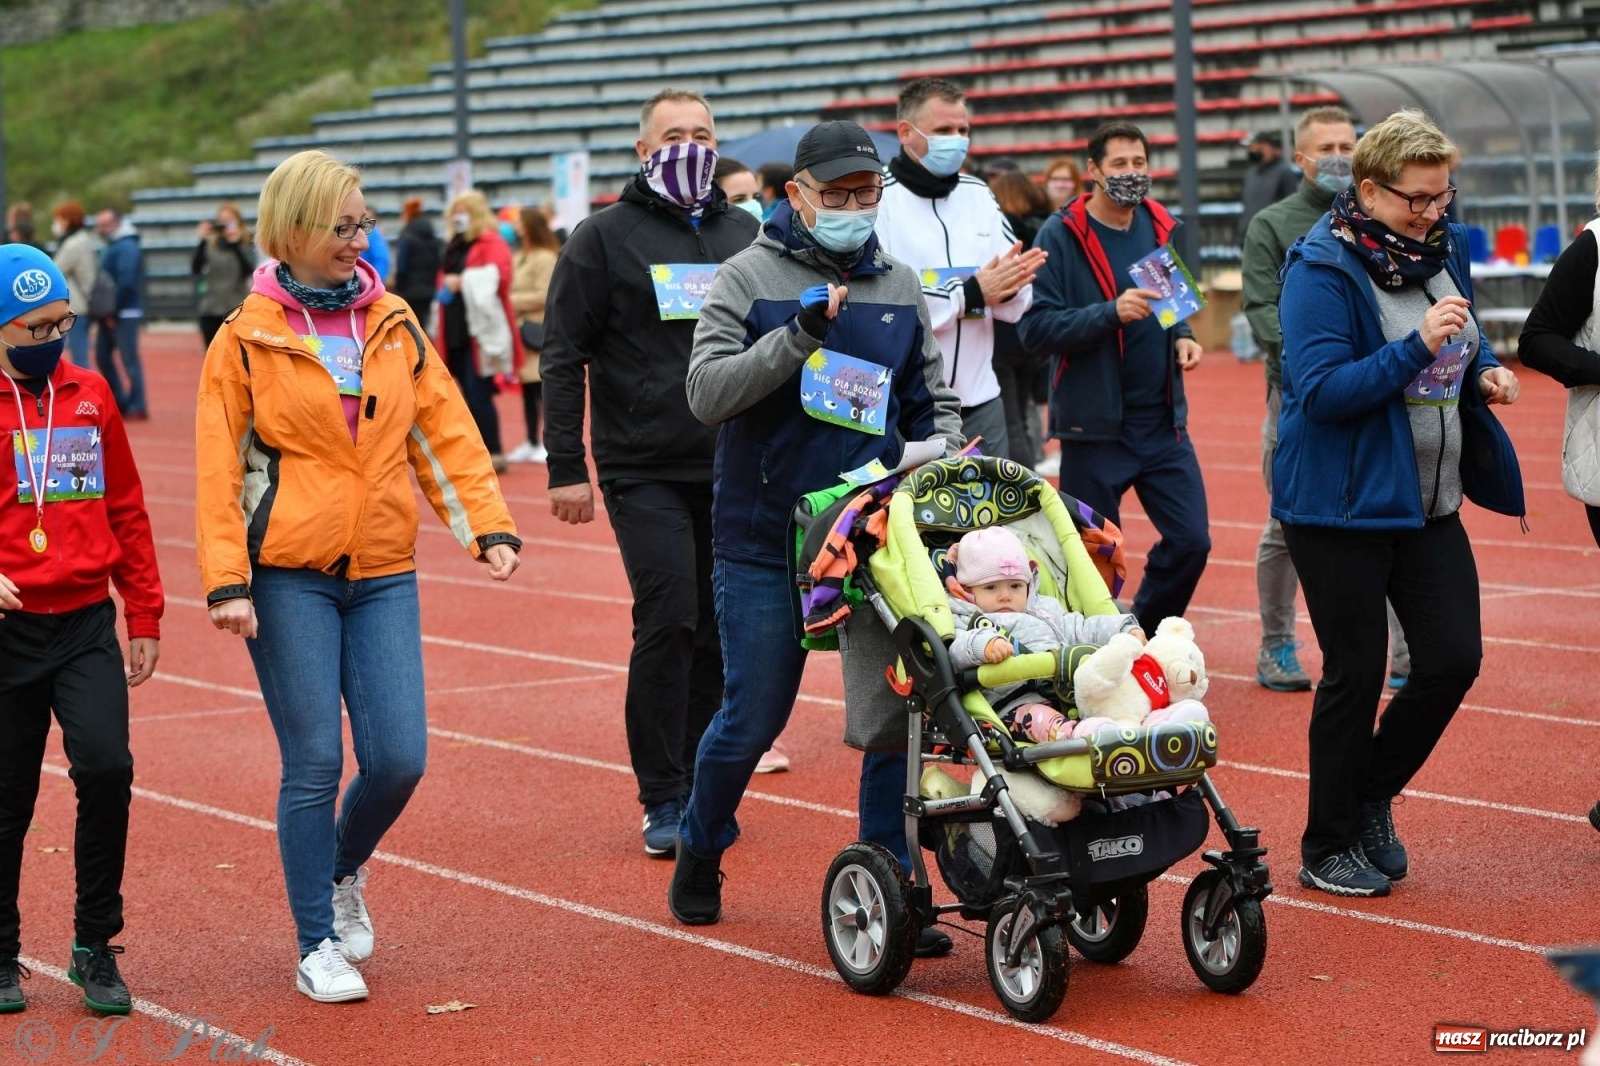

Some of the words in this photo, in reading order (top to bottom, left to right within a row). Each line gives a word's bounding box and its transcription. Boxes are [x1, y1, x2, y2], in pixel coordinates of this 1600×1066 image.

[17, 272, 46, 294] LKS
[881, 313, 895, 324] 4F
[337, 356, 353, 364] DLA
[1432, 367, 1445, 375] DLA
[813, 373, 831, 385] BIEG
[835, 378, 849, 390] DLA
[850, 407, 876, 424] 016
[51, 453, 67, 463] DLA
[70, 476, 97, 493] 074
[1087, 836, 1143, 861] TAKO
